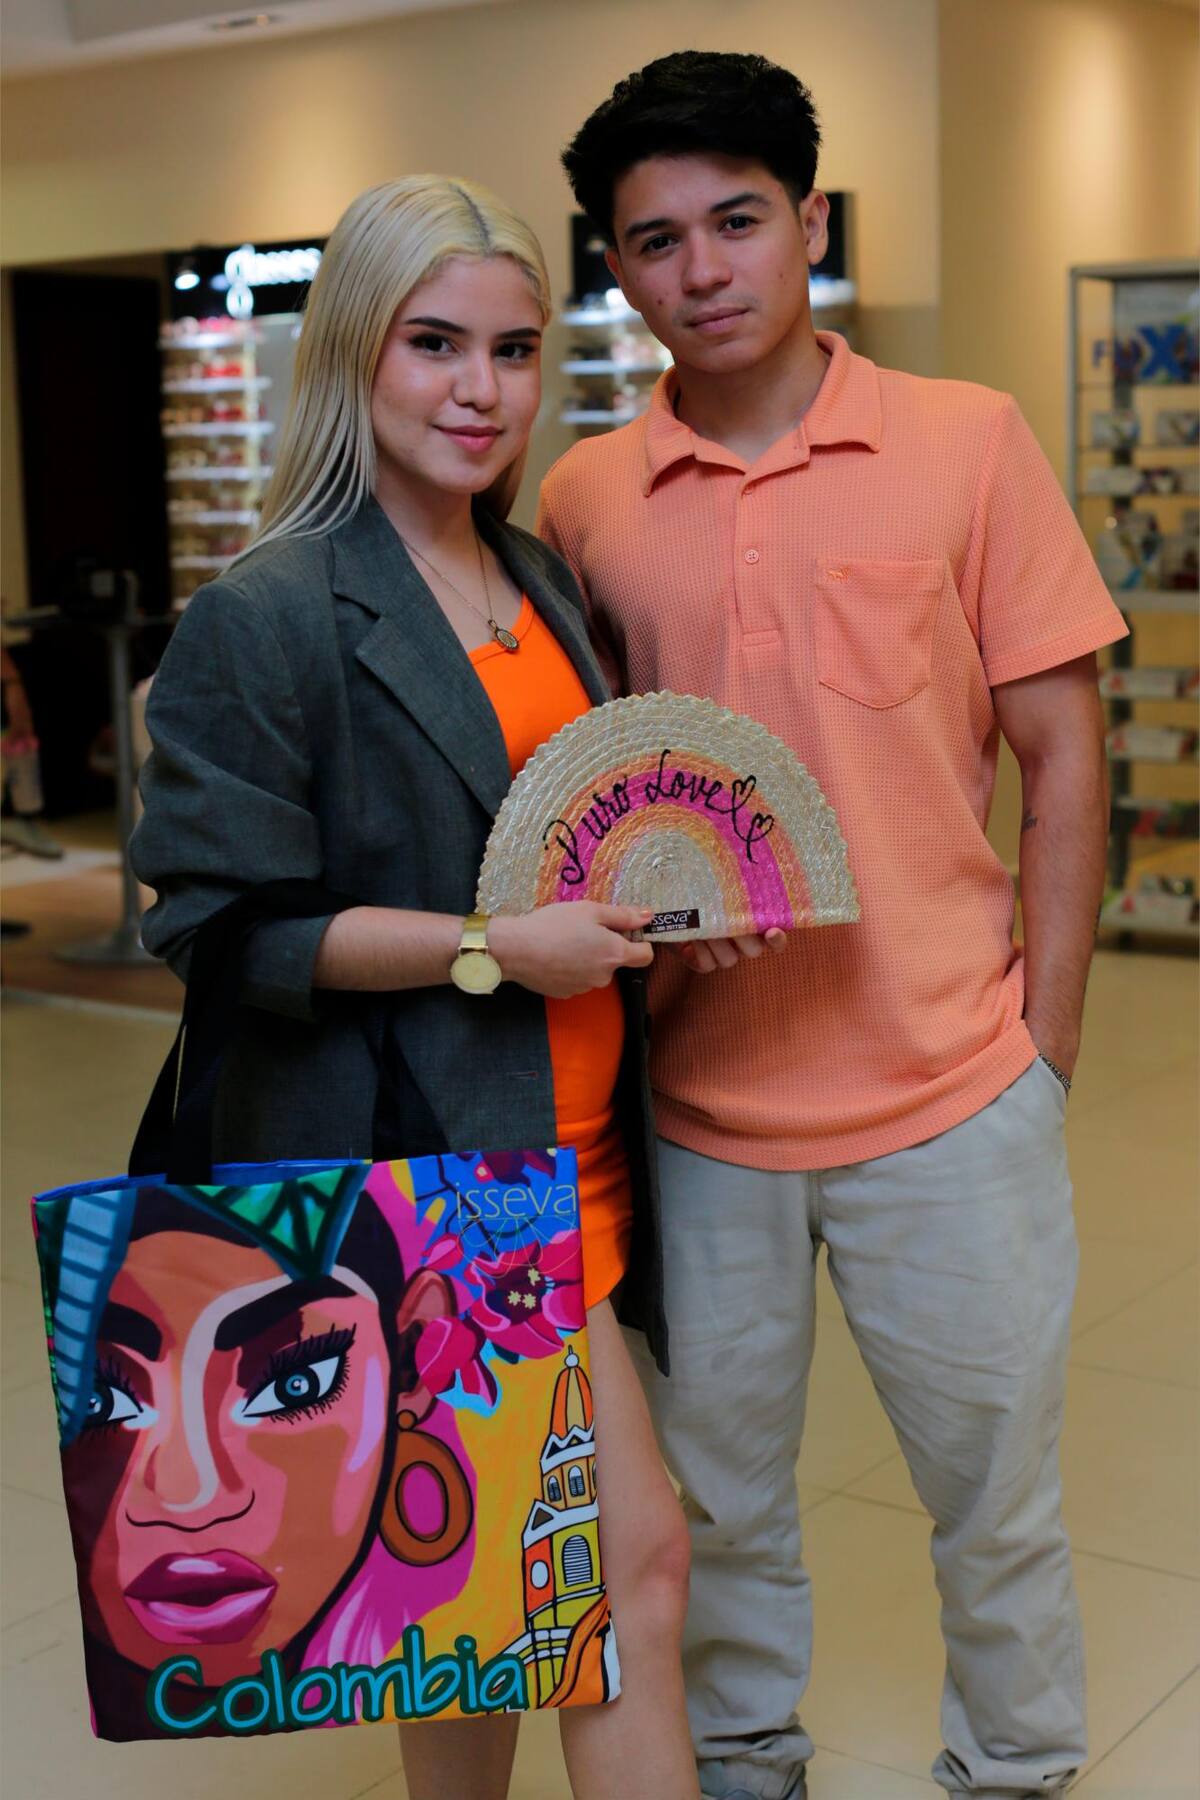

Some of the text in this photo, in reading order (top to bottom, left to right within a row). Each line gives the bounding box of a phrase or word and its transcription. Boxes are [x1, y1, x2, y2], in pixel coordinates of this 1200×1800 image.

[542, 748, 733, 885] Puro Love
[650, 911, 688, 925] sseva
[456, 1182, 577, 1219] isseva
[147, 1624, 528, 1733] Colombia
